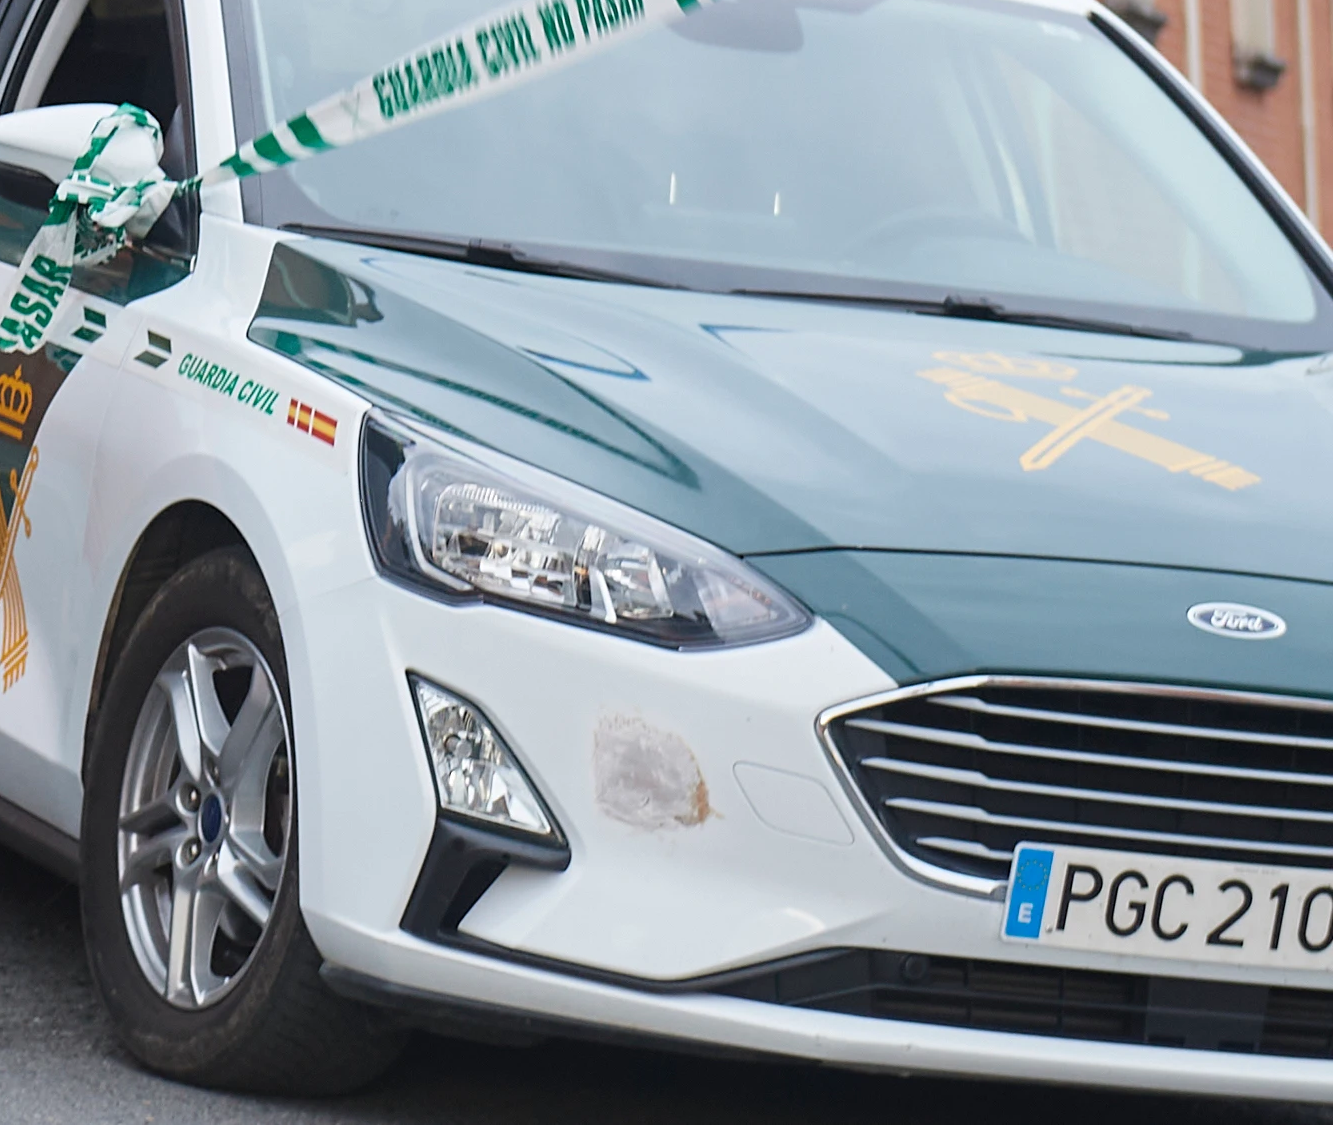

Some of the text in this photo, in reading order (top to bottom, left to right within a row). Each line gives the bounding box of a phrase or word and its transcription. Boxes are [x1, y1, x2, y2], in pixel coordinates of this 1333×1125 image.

[372, 36, 478, 120] GUARDIA
[475, 8, 541, 77] CIVIL
[178, 353, 280, 415] GUARDIA CIVIL
[1210, 609, 1264, 632] Ford
[1018, 902, 1033, 924] E
[1056, 863, 1195, 941] PGC
